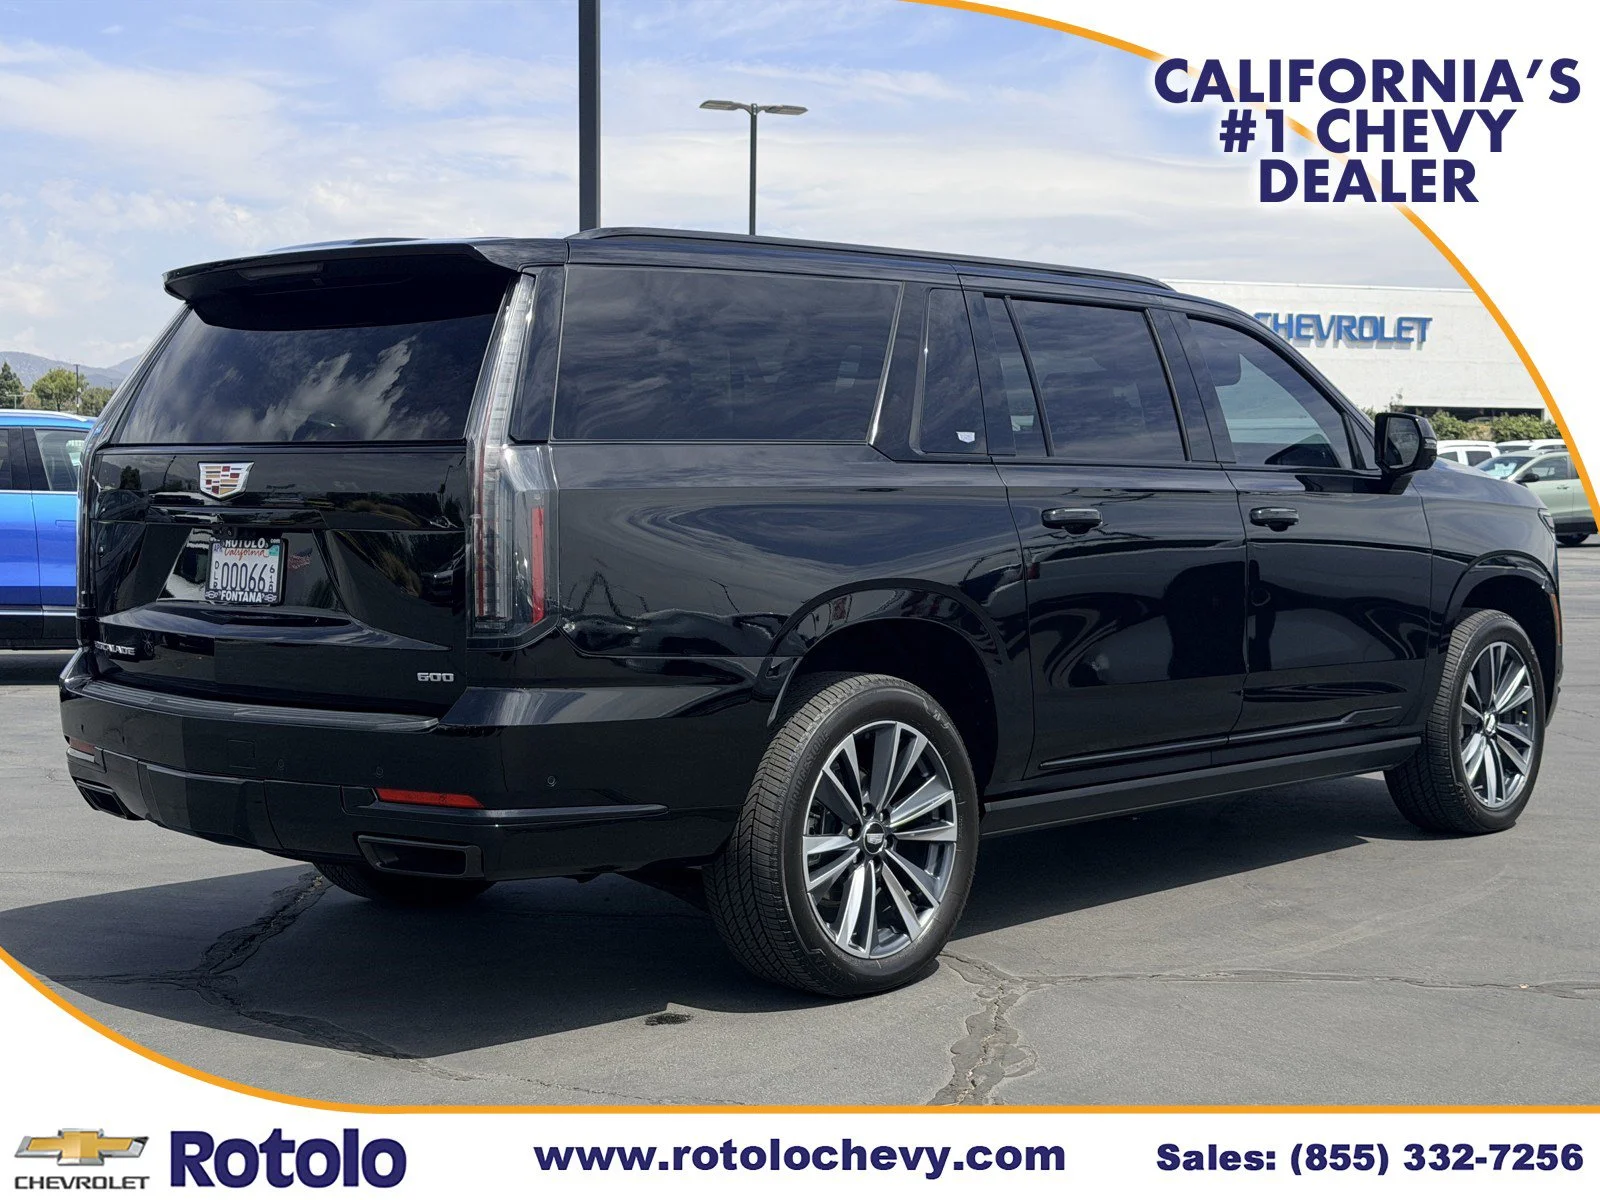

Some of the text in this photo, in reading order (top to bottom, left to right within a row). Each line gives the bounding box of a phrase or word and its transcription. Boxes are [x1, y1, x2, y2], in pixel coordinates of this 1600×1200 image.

[220, 561, 268, 592] 00066
[220, 590, 262, 602] FONTANA
[416, 672, 454, 682] 600
